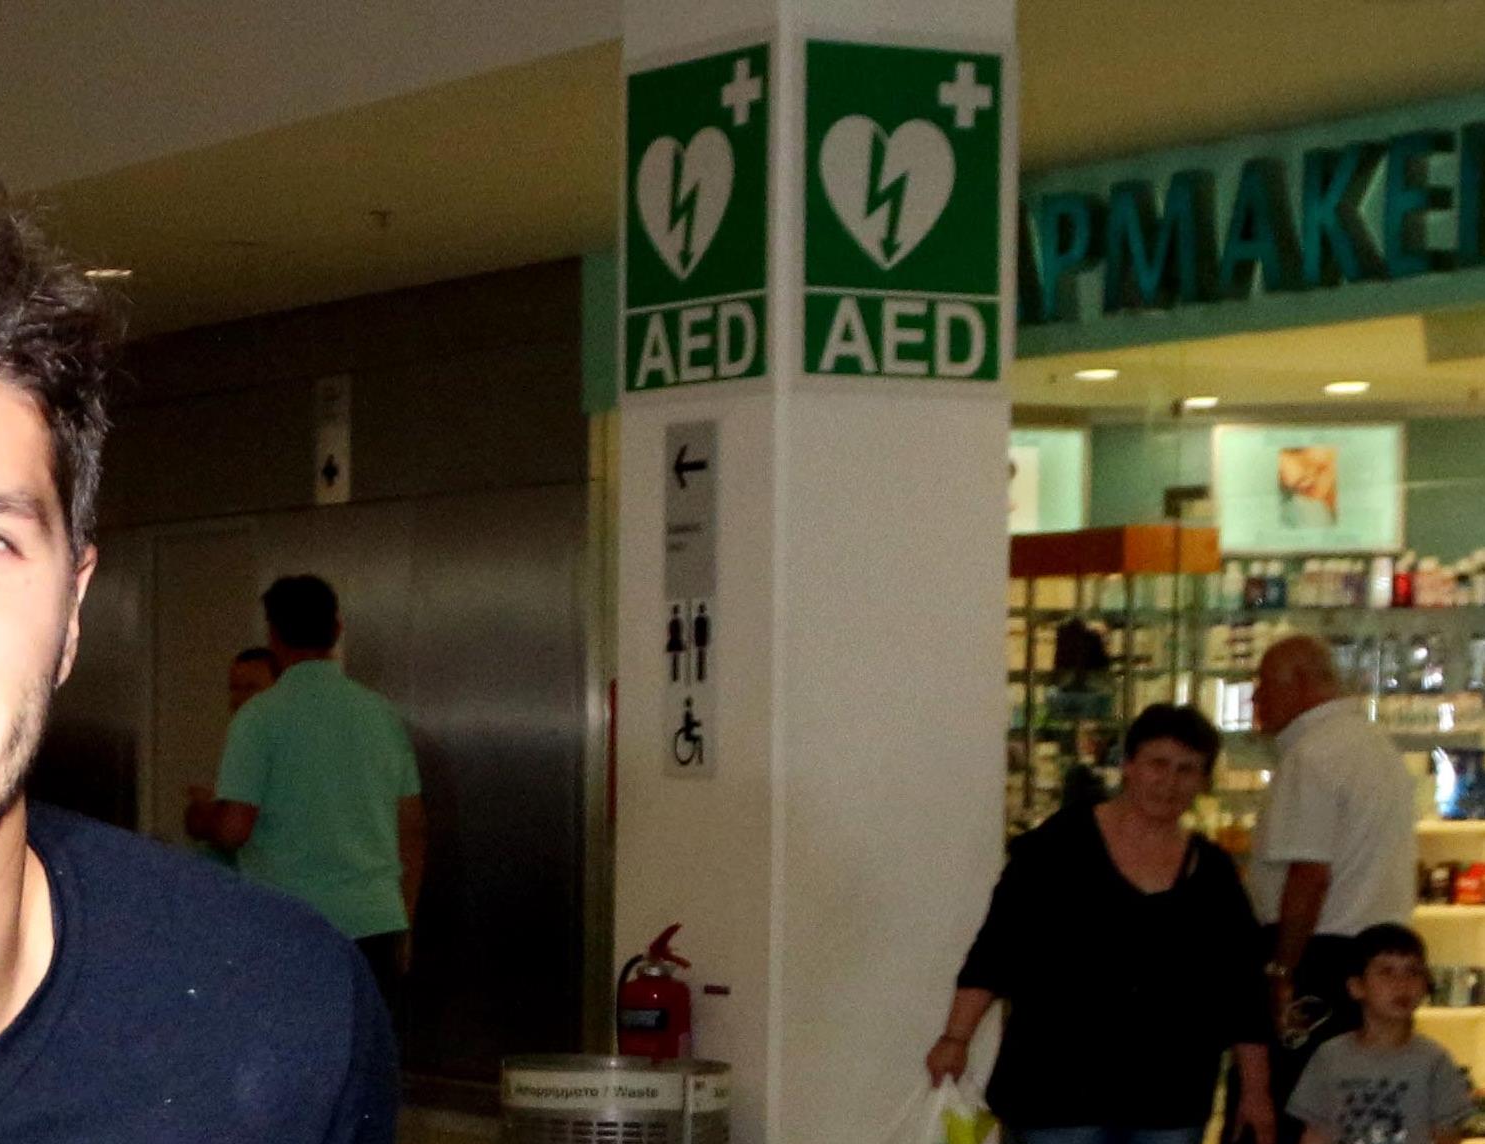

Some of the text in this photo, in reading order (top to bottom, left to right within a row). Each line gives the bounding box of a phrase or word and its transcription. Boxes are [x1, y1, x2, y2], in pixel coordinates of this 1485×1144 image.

[1016, 119, 1485, 324] PMAKE
[635, 299, 757, 388] AED
[818, 294, 987, 378] AED
